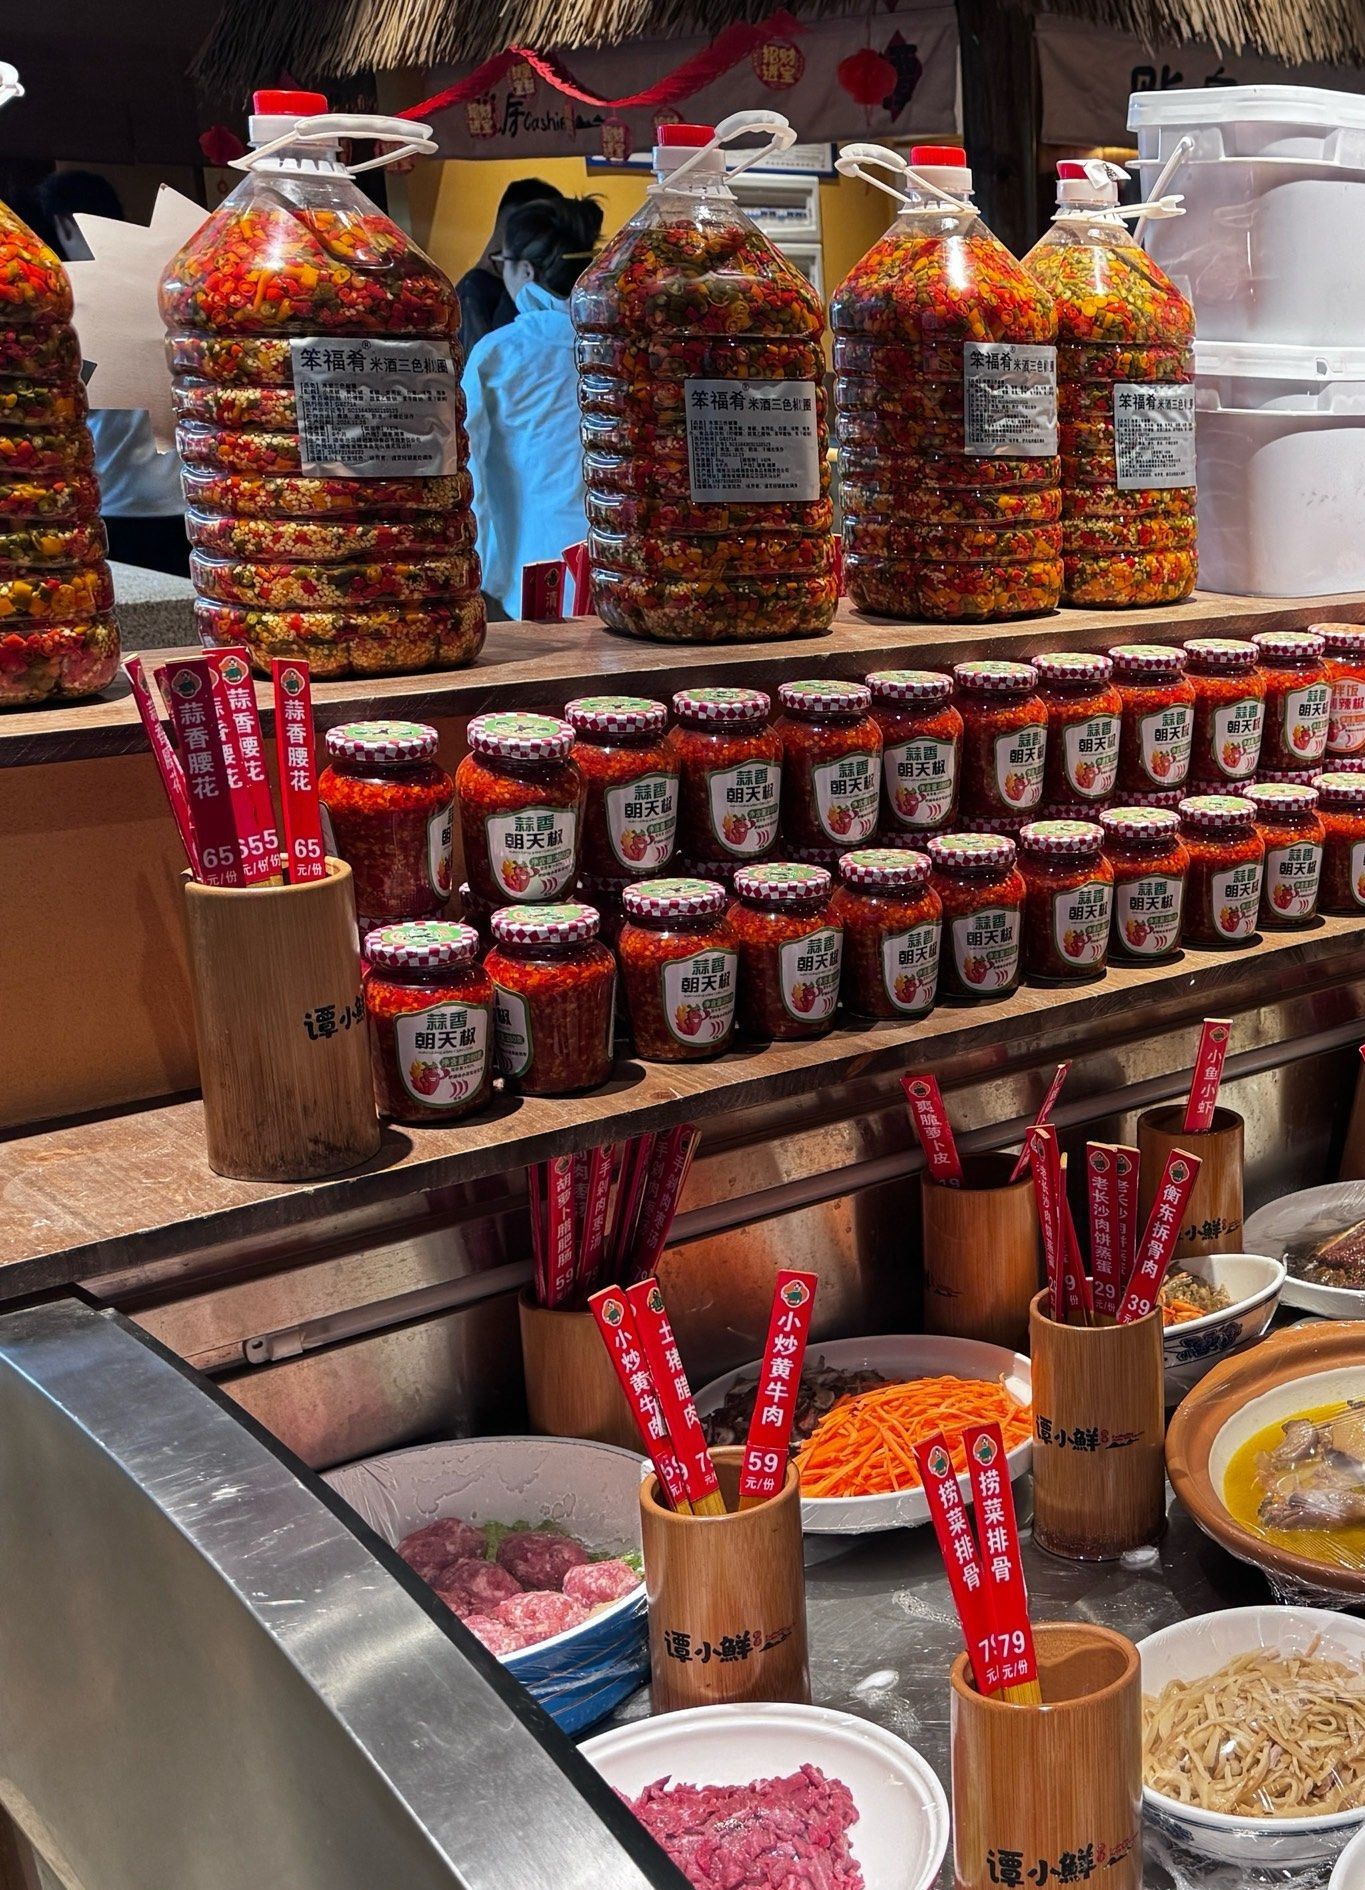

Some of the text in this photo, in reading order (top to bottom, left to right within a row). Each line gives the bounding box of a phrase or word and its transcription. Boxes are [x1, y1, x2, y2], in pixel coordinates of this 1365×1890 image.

[301, 348, 366, 371] 笨福肴
[970, 351, 1013, 371] 笨福肴
[692, 391, 746, 410] 笨福肴
[1119, 393, 1157, 410] 笨福肴
[1307, 690, 1326, 702] 蒜香
[1162, 710, 1186, 726] 蒜香
[1235, 703, 1258, 718] 蒜香
[1087, 721, 1112, 737] 蒜香
[179, 701, 220, 800] 蒜香腰花
[284, 700, 312, 791] 蒜香腰花
[906, 745, 938, 761] 蒜香
[736, 768, 768, 785] 蒜香
[839, 759, 869, 777] 蒜香
[897, 760, 946, 777] 朝天椒
[634, 782, 667, 801] 蒜香
[726, 784, 773, 803] 朝天椒
[830, 774, 875, 795] 朝天椒
[625, 796, 673, 819] 朝天椒
[515, 814, 554, 832] 蒜香
[295, 839, 321, 858] 65
[505, 829, 562, 849] 朝天椒
[202, 846, 234, 868] 65
[1288, 848, 1313, 862] 蒜香
[297, 864, 322, 876] 元/份
[1137, 882, 1167, 897] 蒜香
[1129, 894, 1174, 910] 朝天椒
[975, 914, 1006, 929] 蒜香
[807, 935, 835, 954] 蒜香
[908, 928, 934, 947] 蒜香
[967, 927, 1012, 945] 朝天椒
[692, 957, 725, 976] 蒜香
[681, 972, 730, 993] 朝天椒
[427, 1010, 467, 1030] 蒜香
[415, 1027, 476, 1049] 朝天椒
[1197, 1049, 1222, 1114] 小鱼小虾
[1092, 1176, 1112, 1274] 老长沙肉饼蒸蛋
[1141, 1184, 1182, 1279] 衡东拆骨肉
[1094, 1281, 1115, 1298] 29
[1128, 1295, 1150, 1315] 39
[659, 1320, 701, 1429] 土猪腊肉
[762, 1312, 801, 1427] 小炒黄牛肉
[748, 1452, 778, 1472] 59
[745, 1477, 775, 1491] 元/份
[938, 1479, 980, 1592] 捞菜排骨
[979, 1469, 1012, 1583] 捞菜排骨
[665, 1630, 753, 1663] 谭小鲜
[997, 1630, 1025, 1658] 79
[1002, 1660, 1028, 1679] 元/份
[987, 1843, 1096, 1887] 谭小鲜
